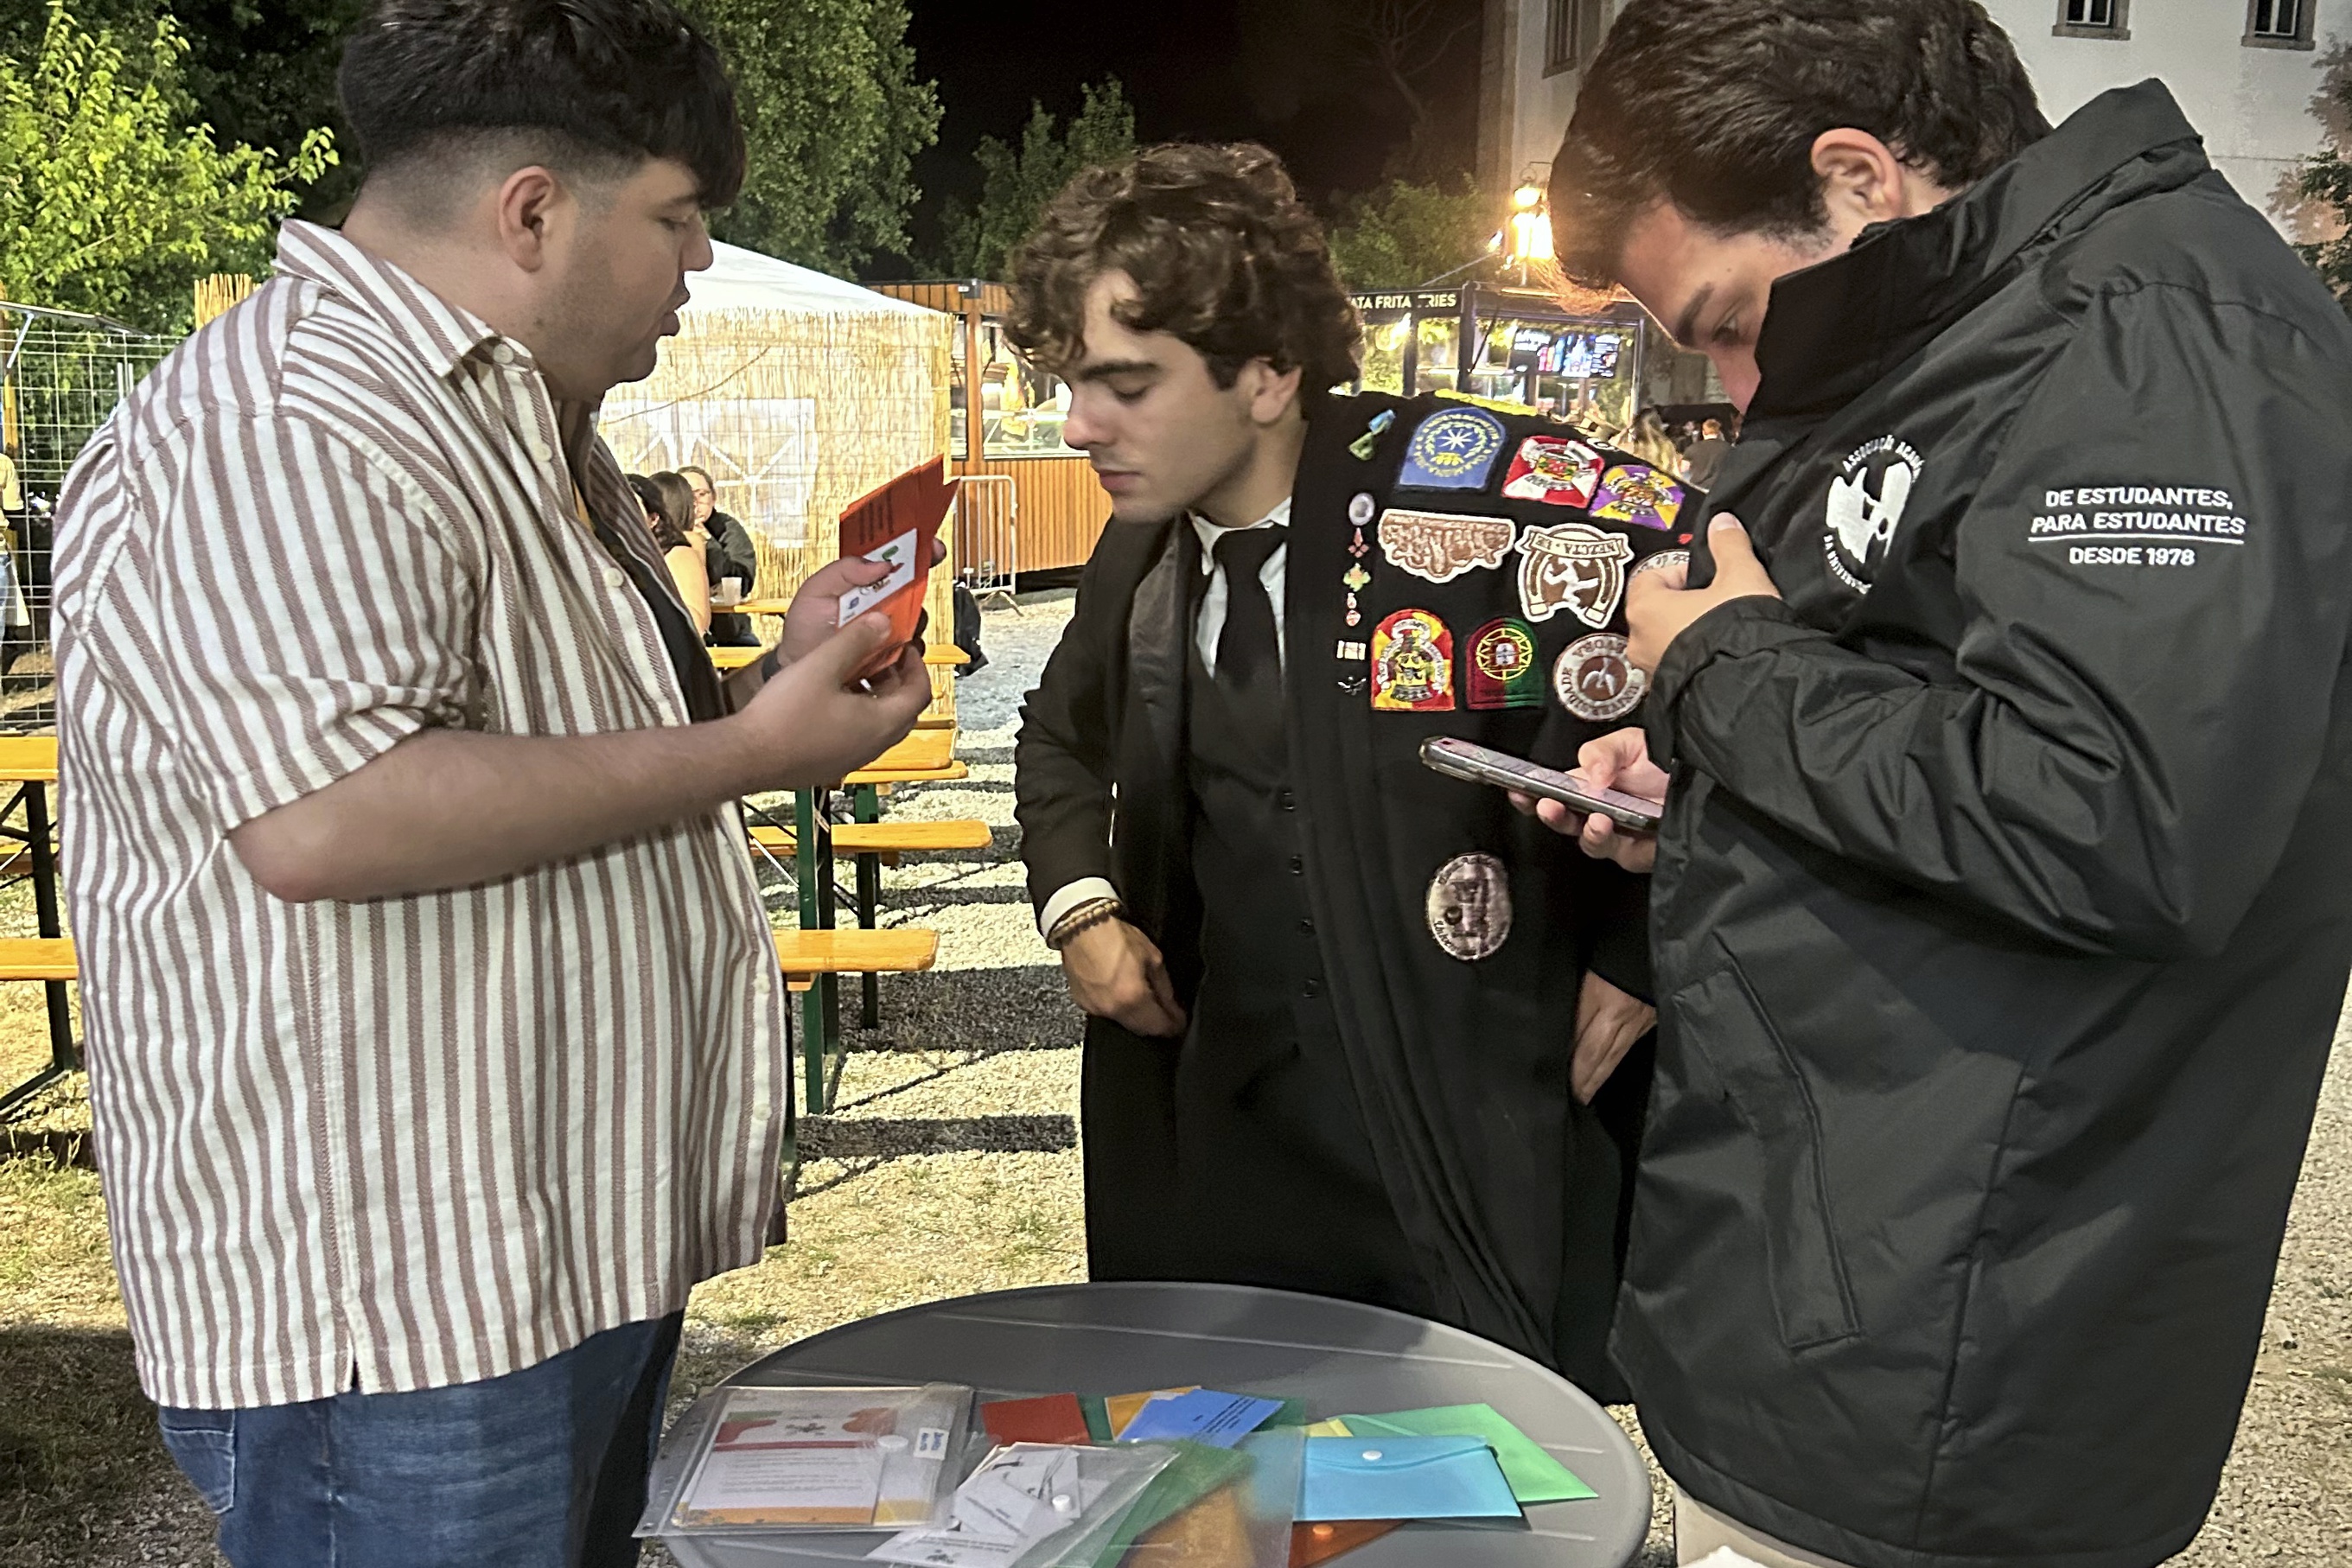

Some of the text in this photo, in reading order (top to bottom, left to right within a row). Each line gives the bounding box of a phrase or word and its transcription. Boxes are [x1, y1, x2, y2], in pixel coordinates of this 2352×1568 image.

[1375, 295, 1412, 309] FRITA
[2045, 487, 2233, 510] DE ESTUDANTES,
[2031, 512, 2247, 534] PARA ESTUDANTES
[2069, 547, 2196, 566] DESDE 1978
